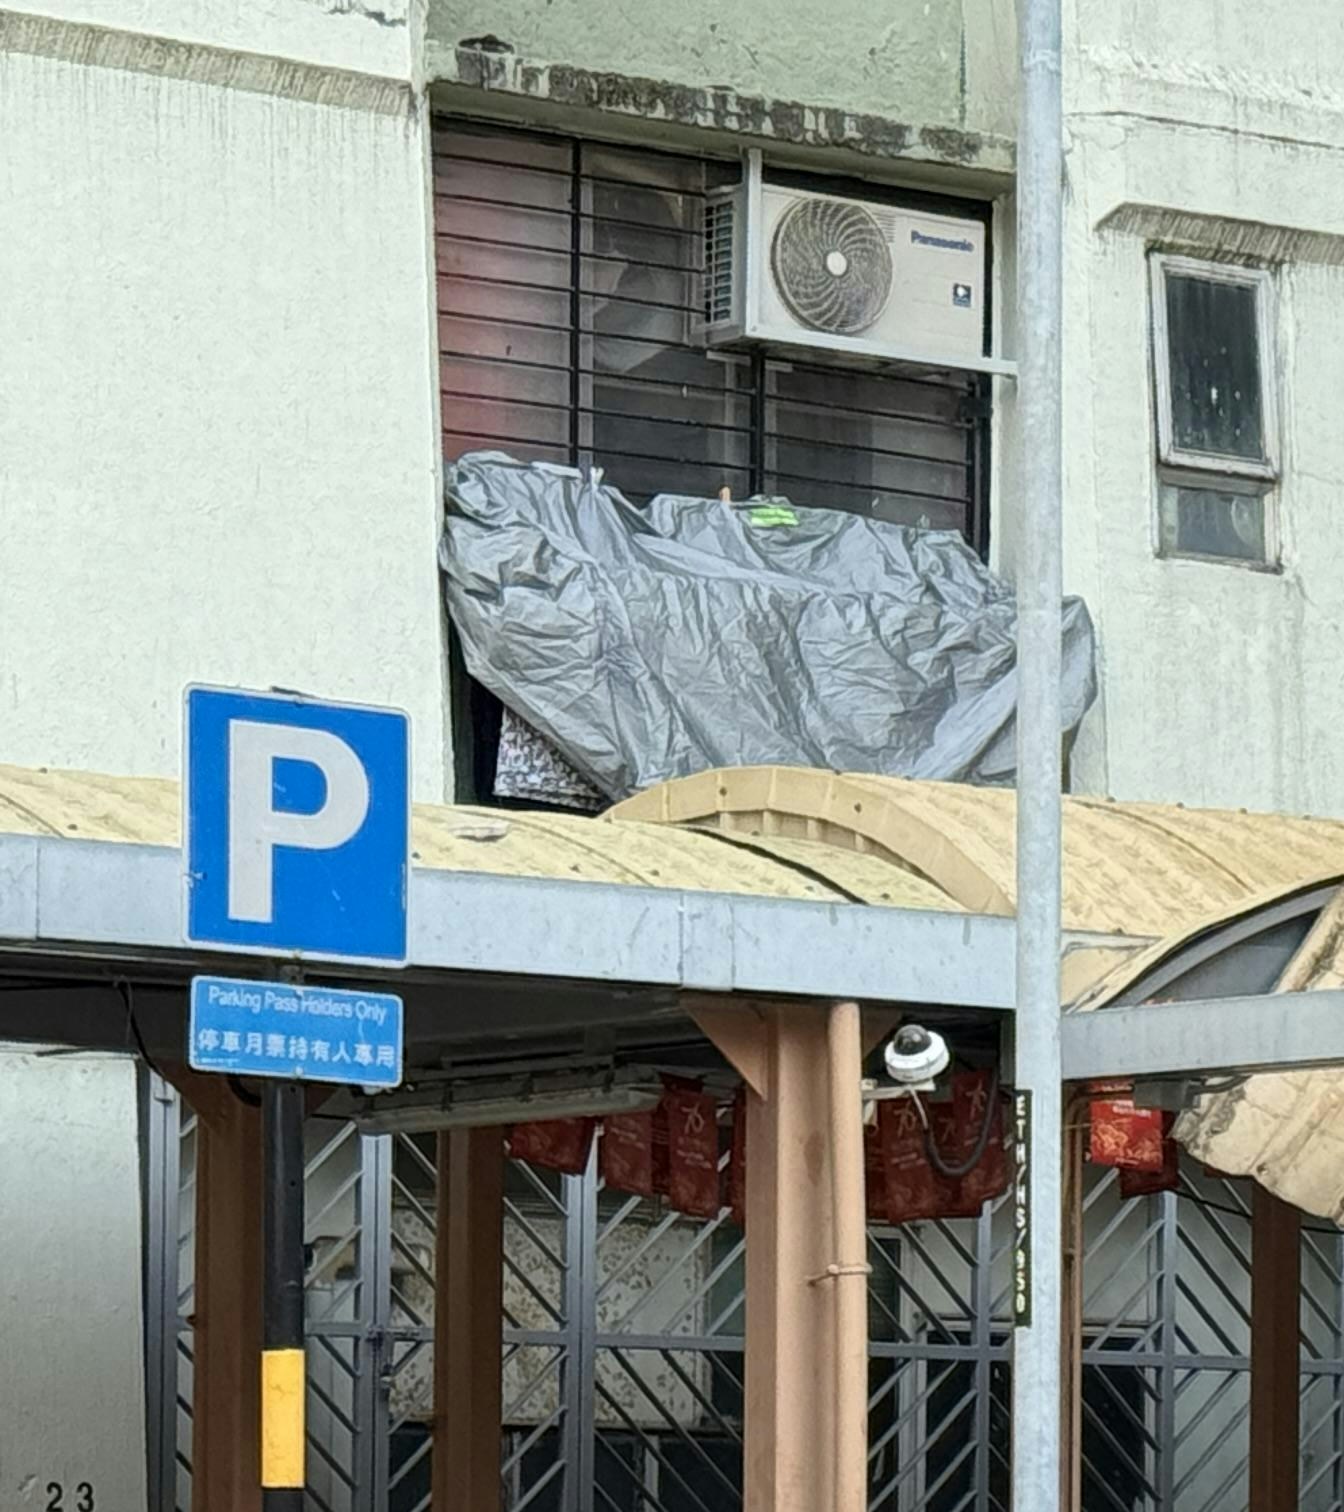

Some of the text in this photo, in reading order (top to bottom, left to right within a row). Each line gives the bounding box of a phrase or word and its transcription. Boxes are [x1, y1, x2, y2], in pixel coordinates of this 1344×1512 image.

[228, 719, 370, 923] P
[208, 985, 388, 1027] Parking Pass Holders Only
